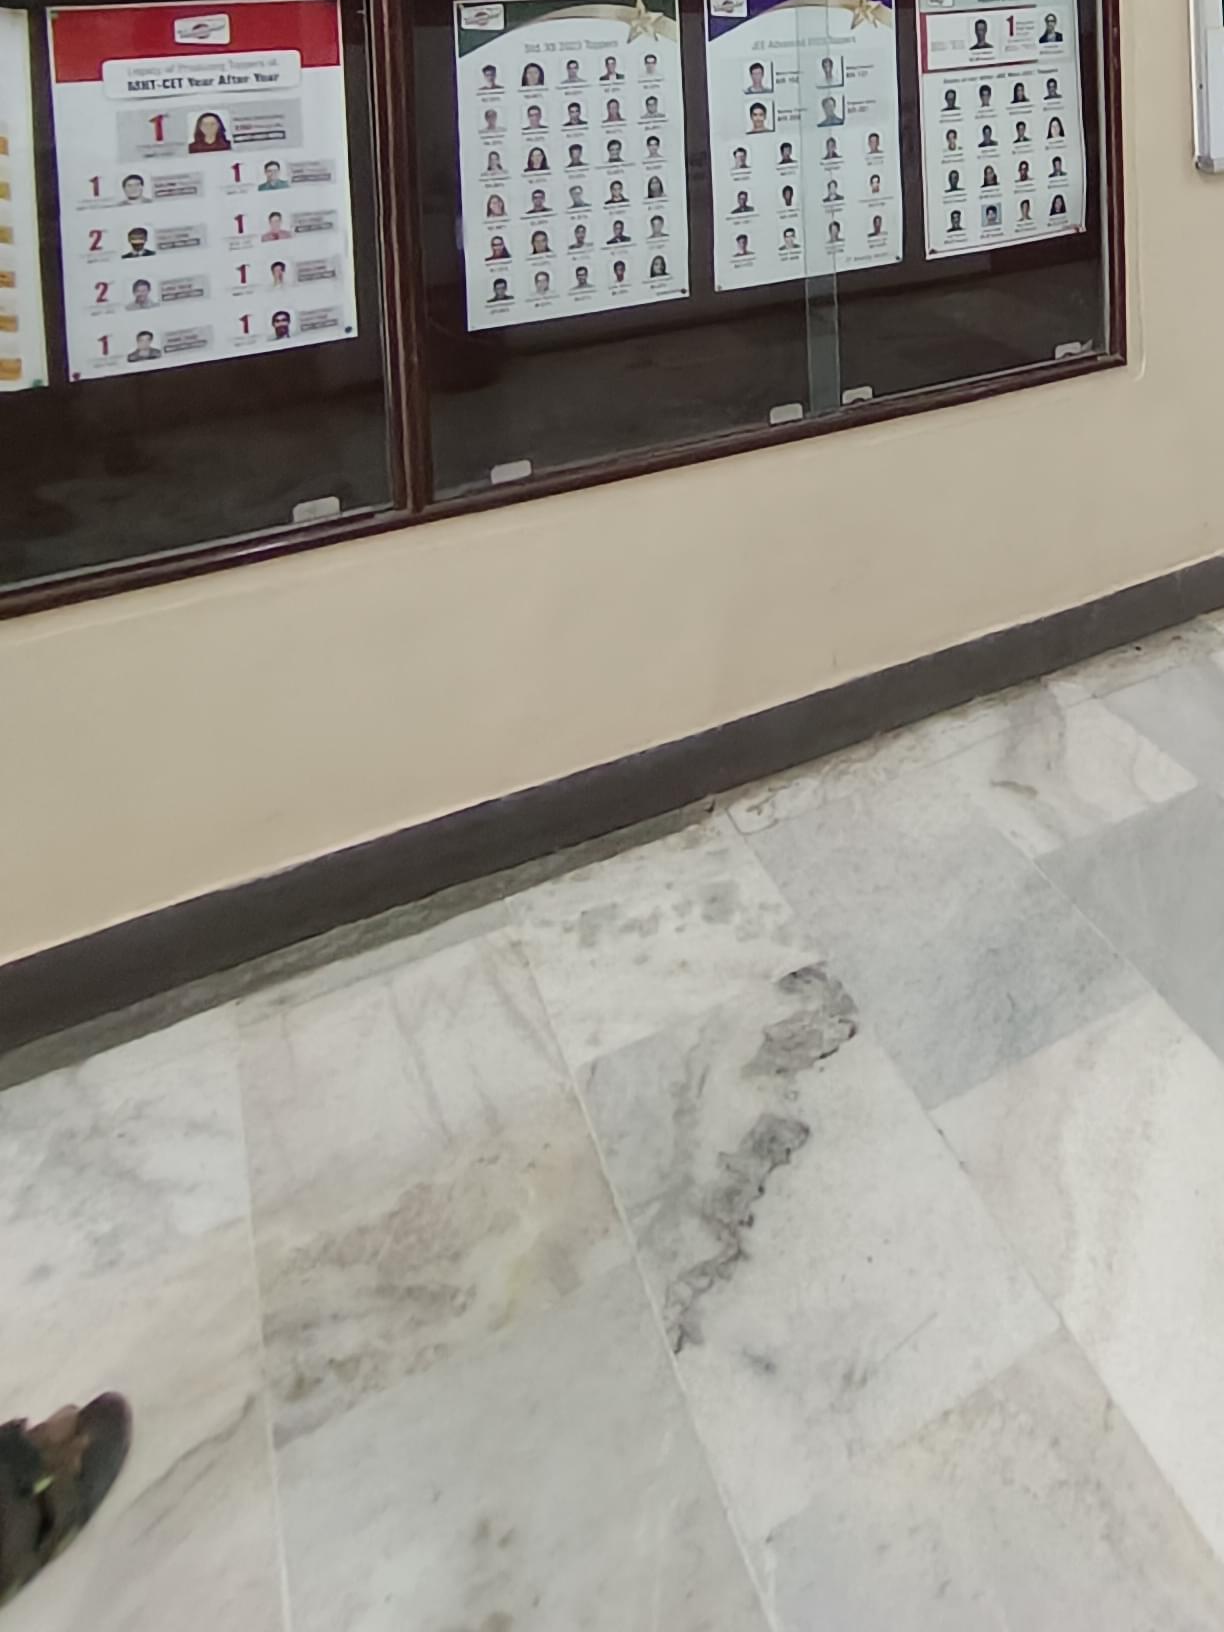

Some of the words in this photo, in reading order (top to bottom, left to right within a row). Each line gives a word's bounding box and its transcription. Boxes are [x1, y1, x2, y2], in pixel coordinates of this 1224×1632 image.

[187, 75, 215, 88] Year
[218, 73, 250, 86] After
[254, 70, 280, 83] Year
